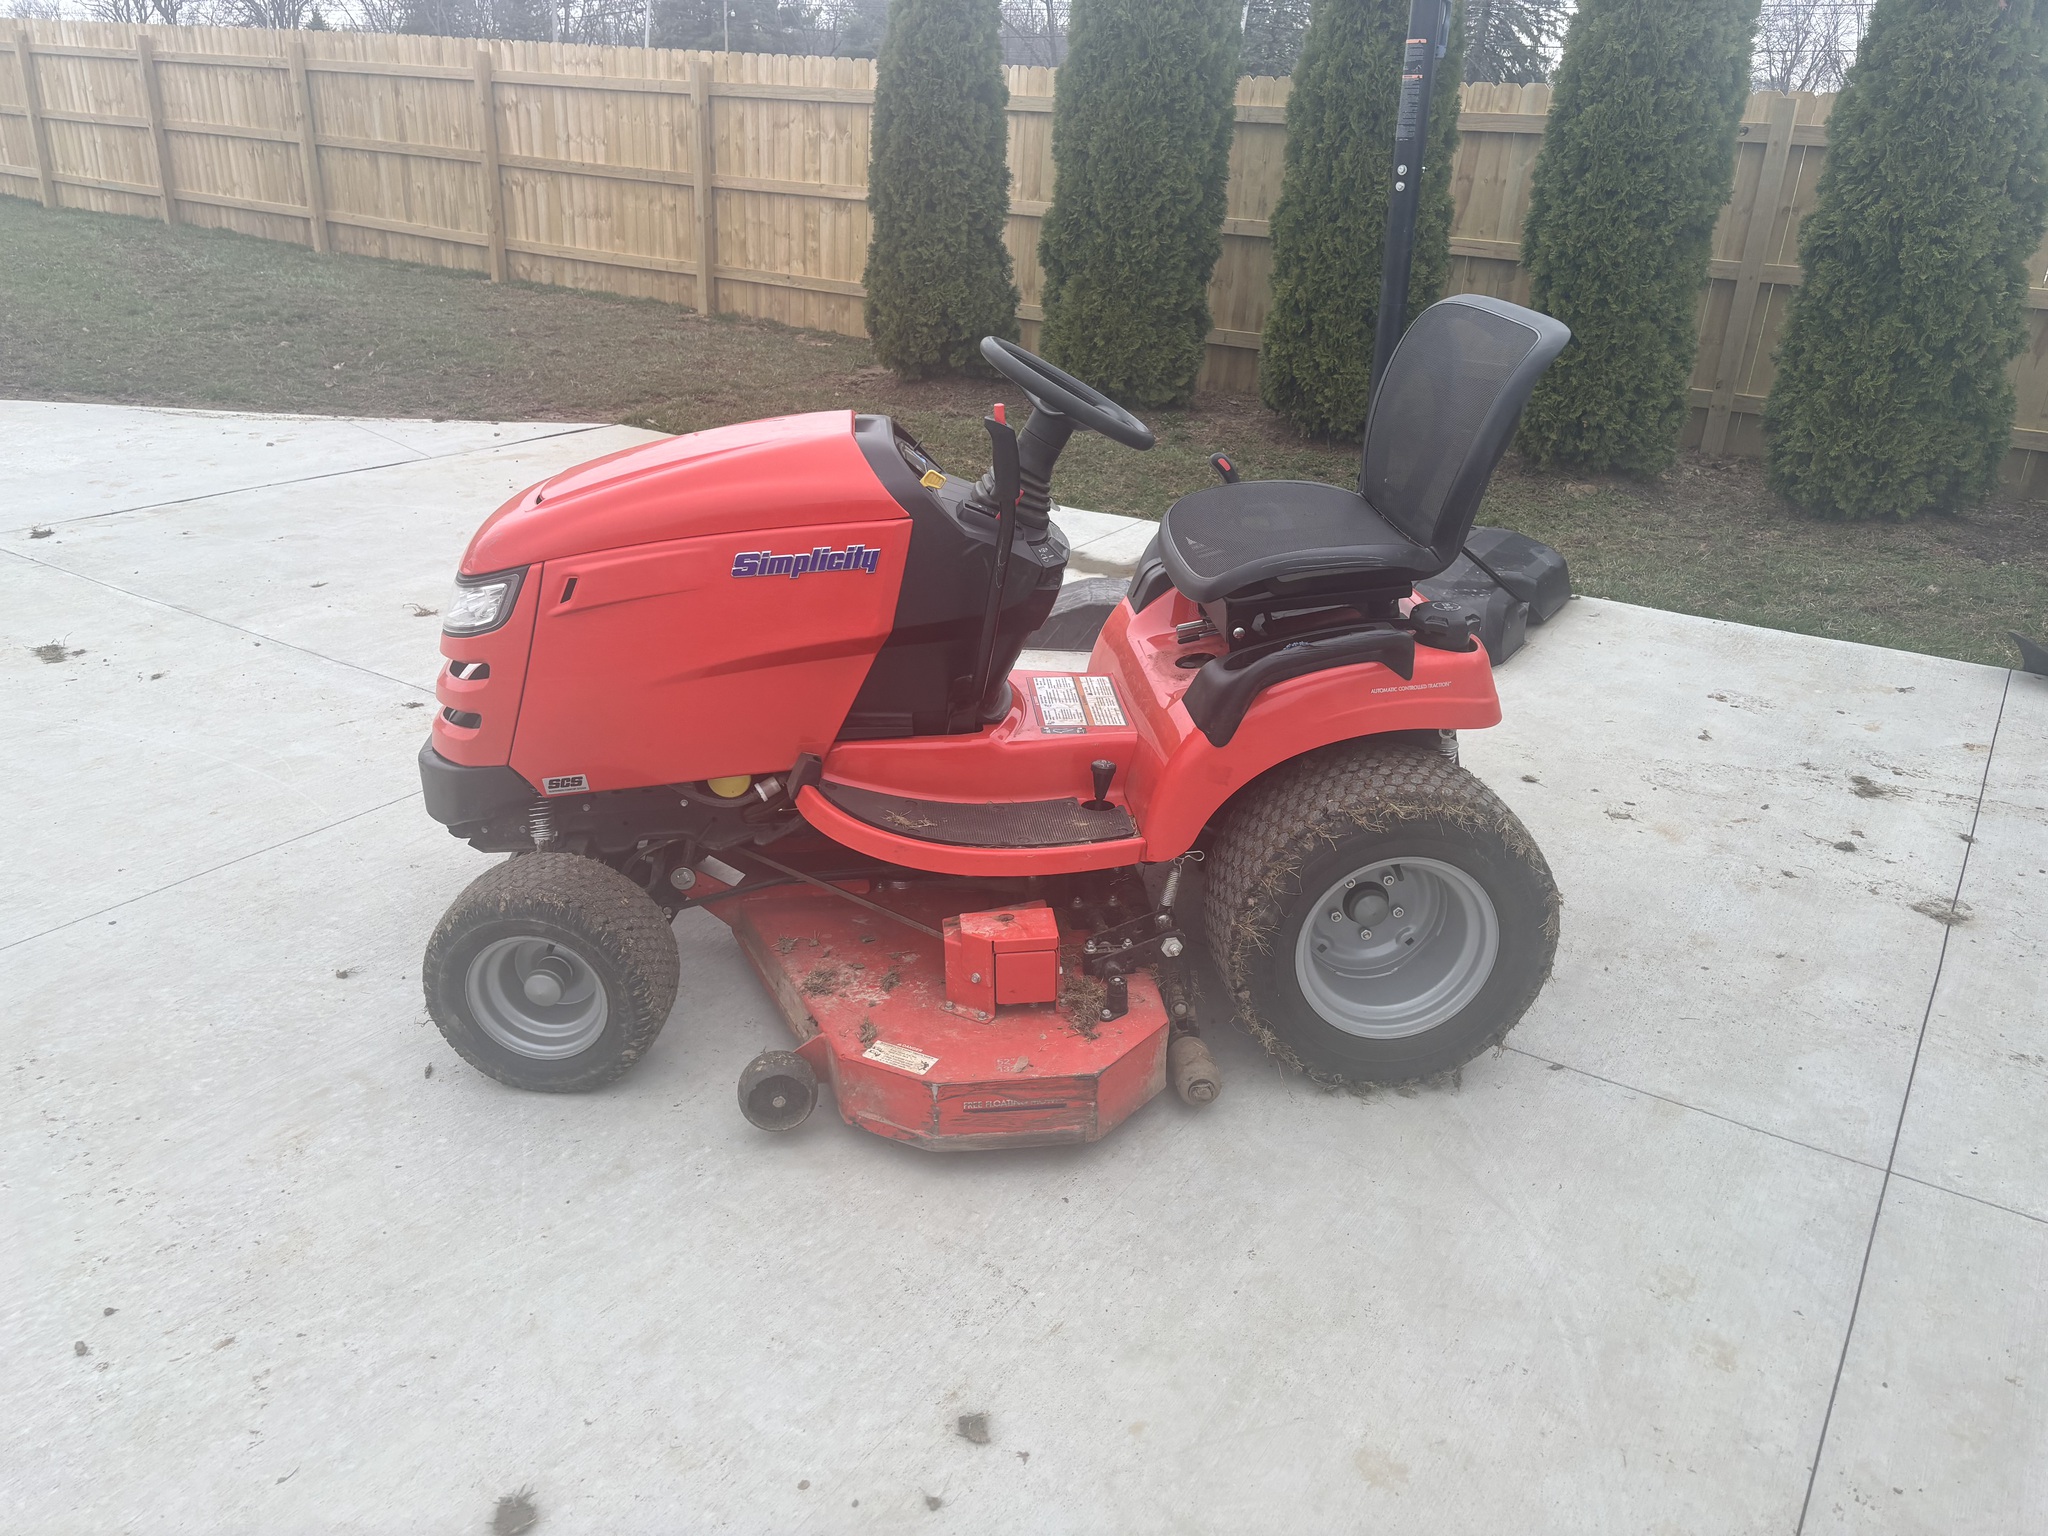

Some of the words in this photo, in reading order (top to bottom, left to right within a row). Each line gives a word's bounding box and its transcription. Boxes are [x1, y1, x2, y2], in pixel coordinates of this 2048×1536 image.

[731, 544, 881, 579] Simplicity
[1370, 686, 1397, 694] AUTOMATIC
[1398, 684, 1427, 692] CONTROLLED
[548, 776, 583, 789] SCS
[963, 1101, 983, 1110] FREE
